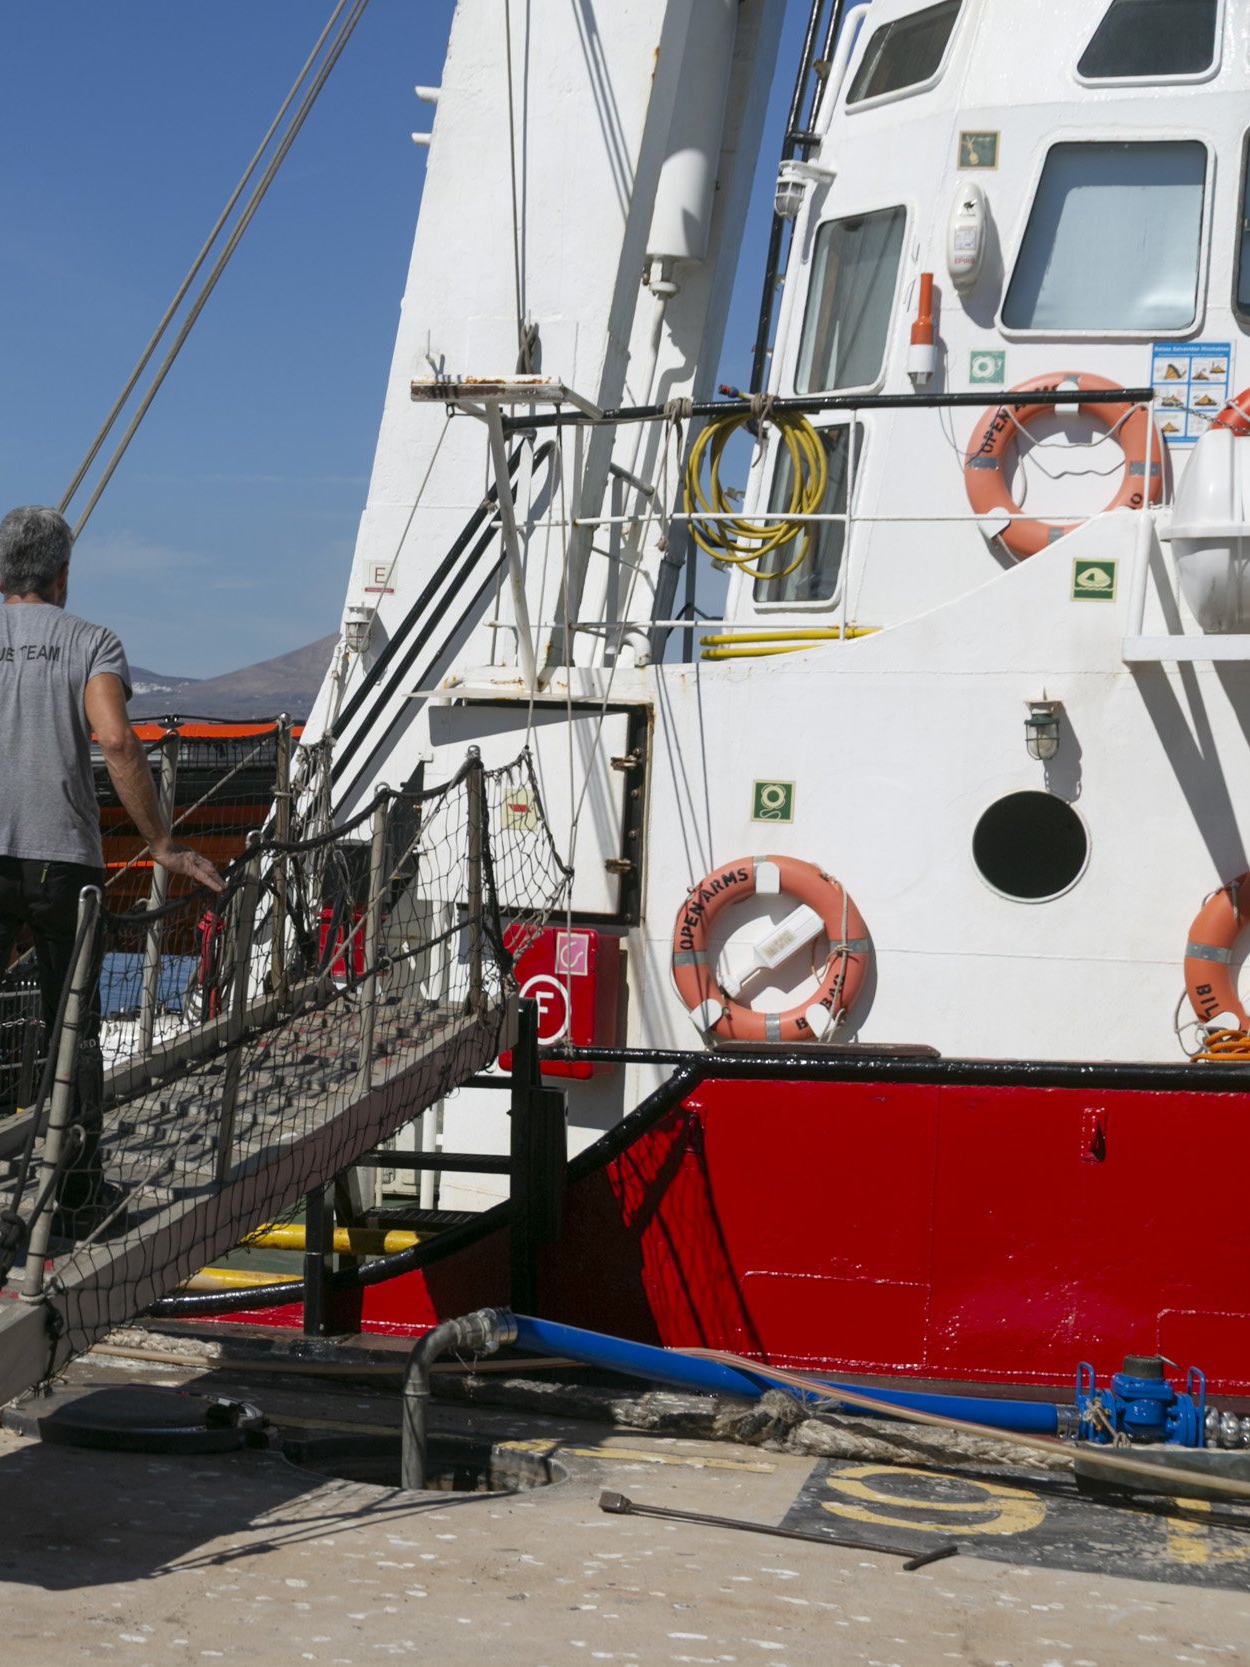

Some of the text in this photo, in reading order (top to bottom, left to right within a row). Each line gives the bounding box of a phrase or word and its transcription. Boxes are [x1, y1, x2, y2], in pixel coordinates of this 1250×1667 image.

[375, 567, 387, 584] E
[20, 645, 61, 662] TEAM
[680, 867, 749, 951] OPEN ARMS
